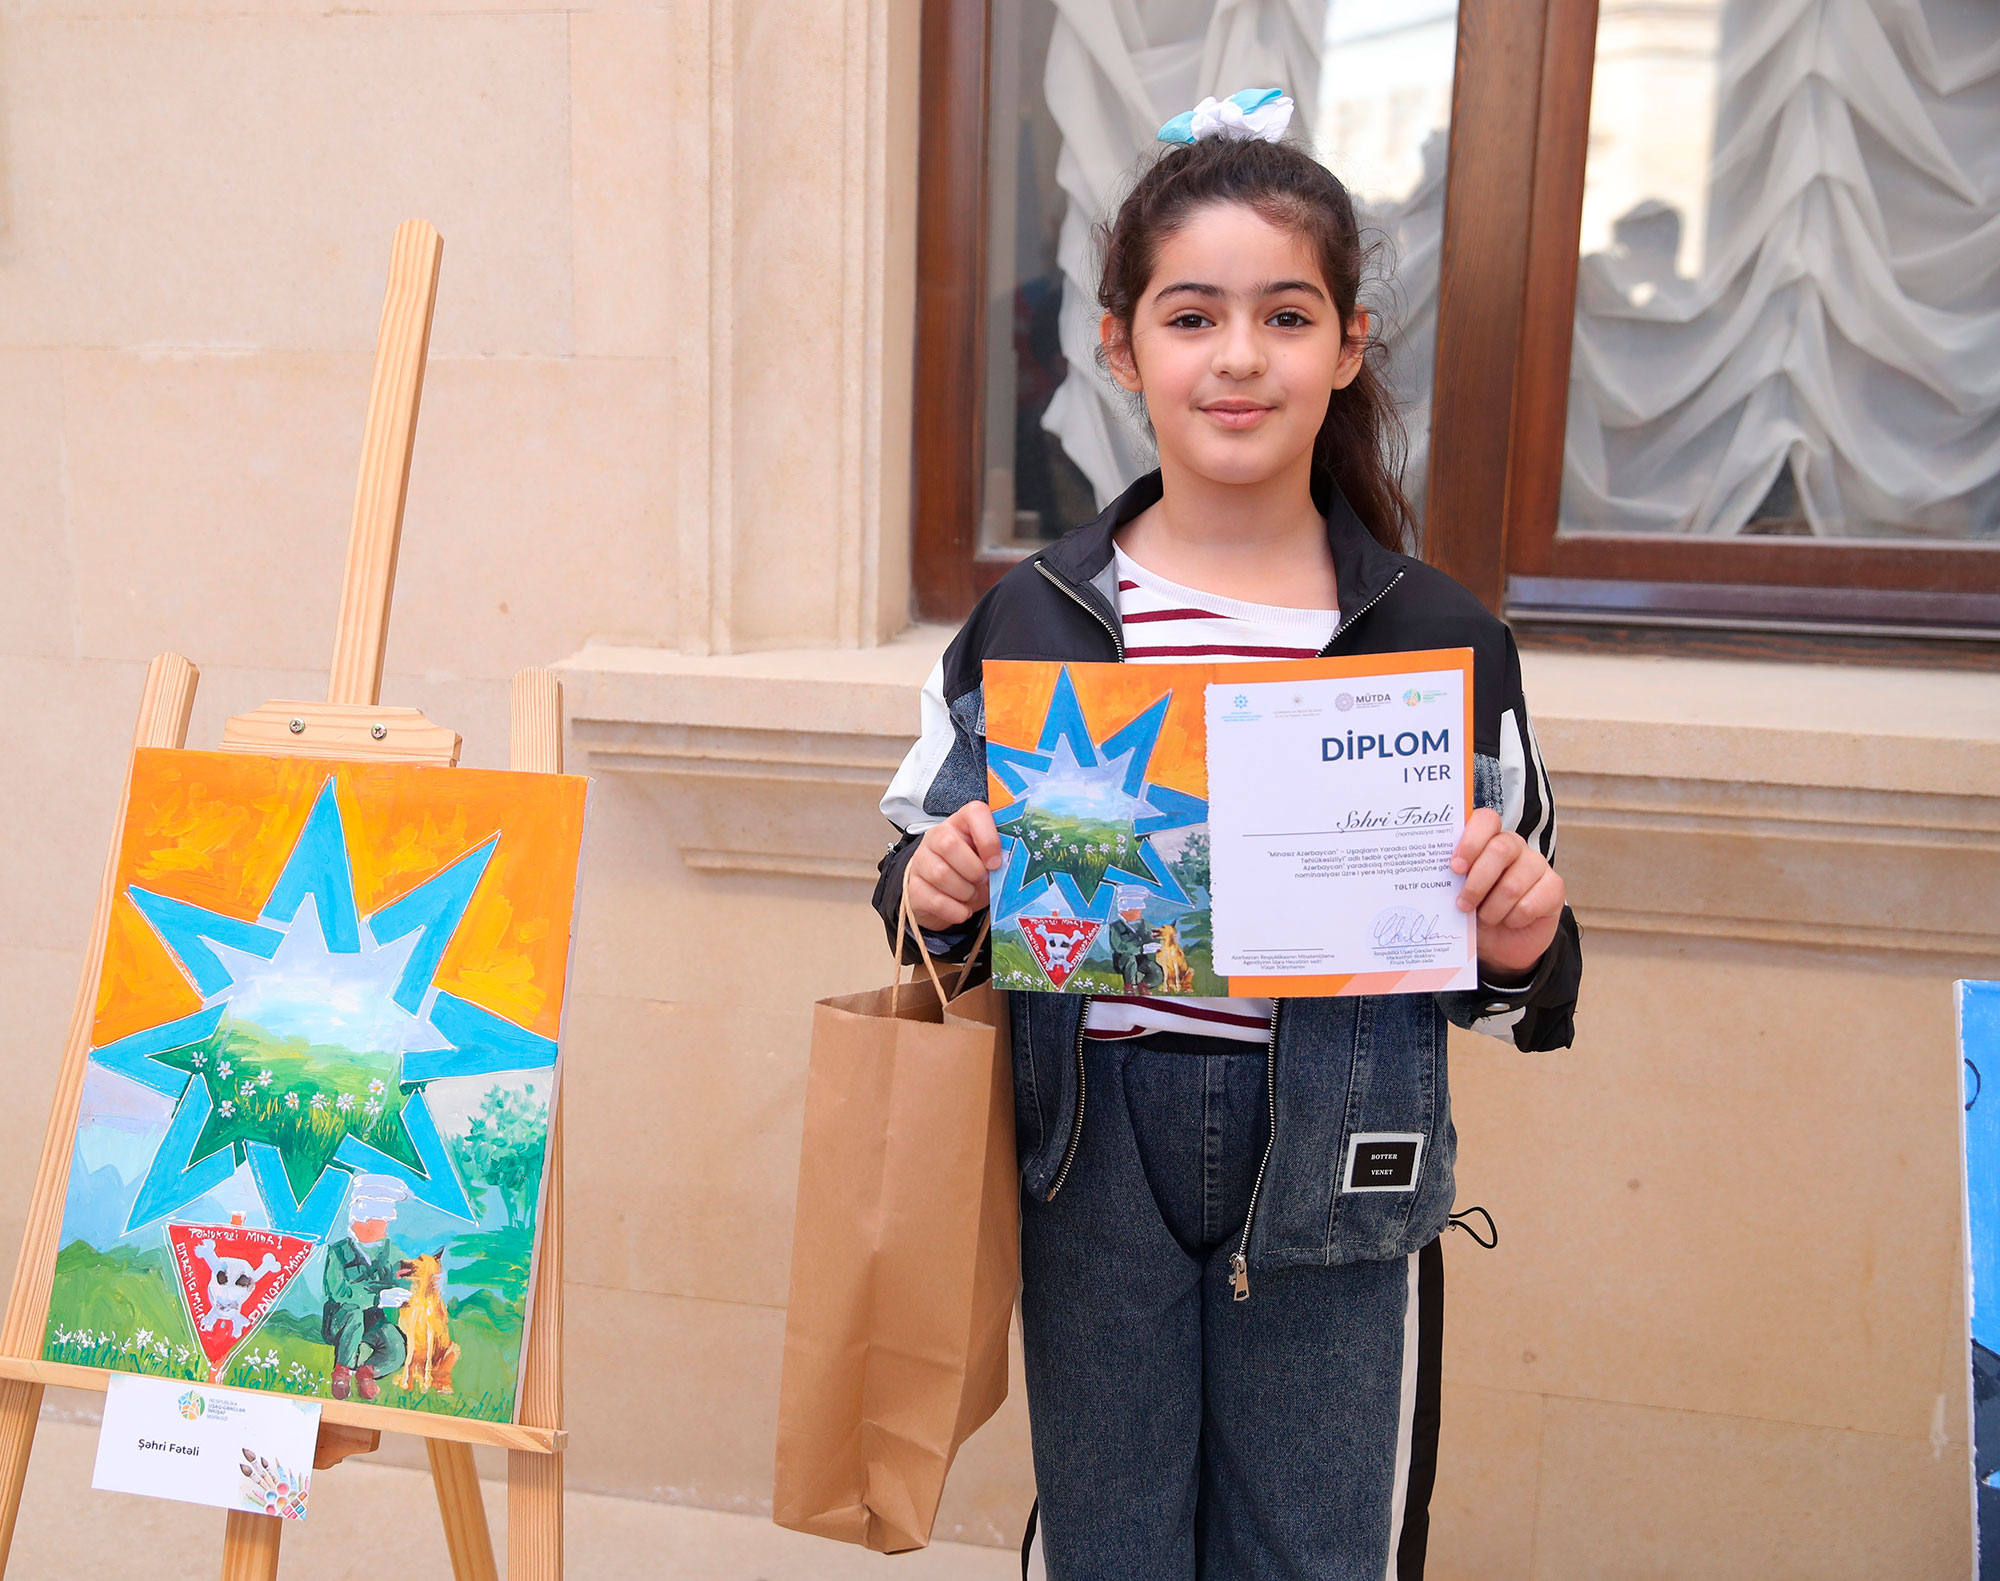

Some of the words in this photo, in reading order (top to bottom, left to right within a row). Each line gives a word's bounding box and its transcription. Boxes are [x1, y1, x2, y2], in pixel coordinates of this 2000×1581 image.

[1356, 693, 1391, 704] MÜTDA
[1321, 729, 1449, 762] DİPLOM
[1404, 768, 1408, 783] I
[1413, 764, 1451, 782] YER
[1394, 804, 1453, 826] Fətəli
[1394, 883, 1419, 891] TƏLTİF
[1420, 881, 1452, 889] OLUNUR
[138, 1438, 167, 1451] Şəhri
[169, 1443, 200, 1456] Fətəli
